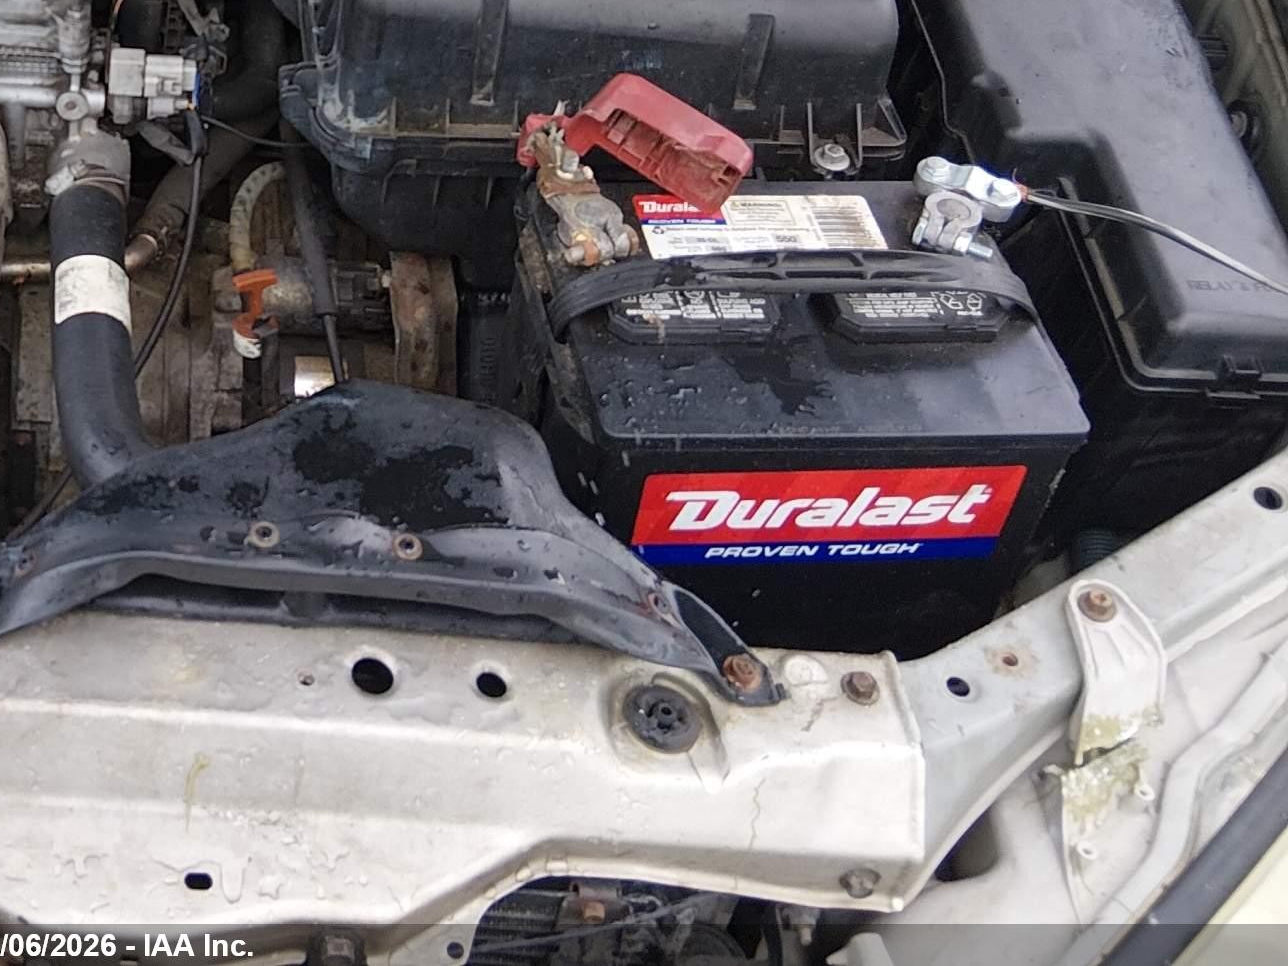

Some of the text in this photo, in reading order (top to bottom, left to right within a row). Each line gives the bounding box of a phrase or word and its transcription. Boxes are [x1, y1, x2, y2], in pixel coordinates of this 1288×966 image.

[638, 200, 702, 213] Durala
[1186, 280, 1233, 291] RELAY
[665, 484, 992, 531] Duralast
[705, 542, 920, 558] PROVEN TOUGH
